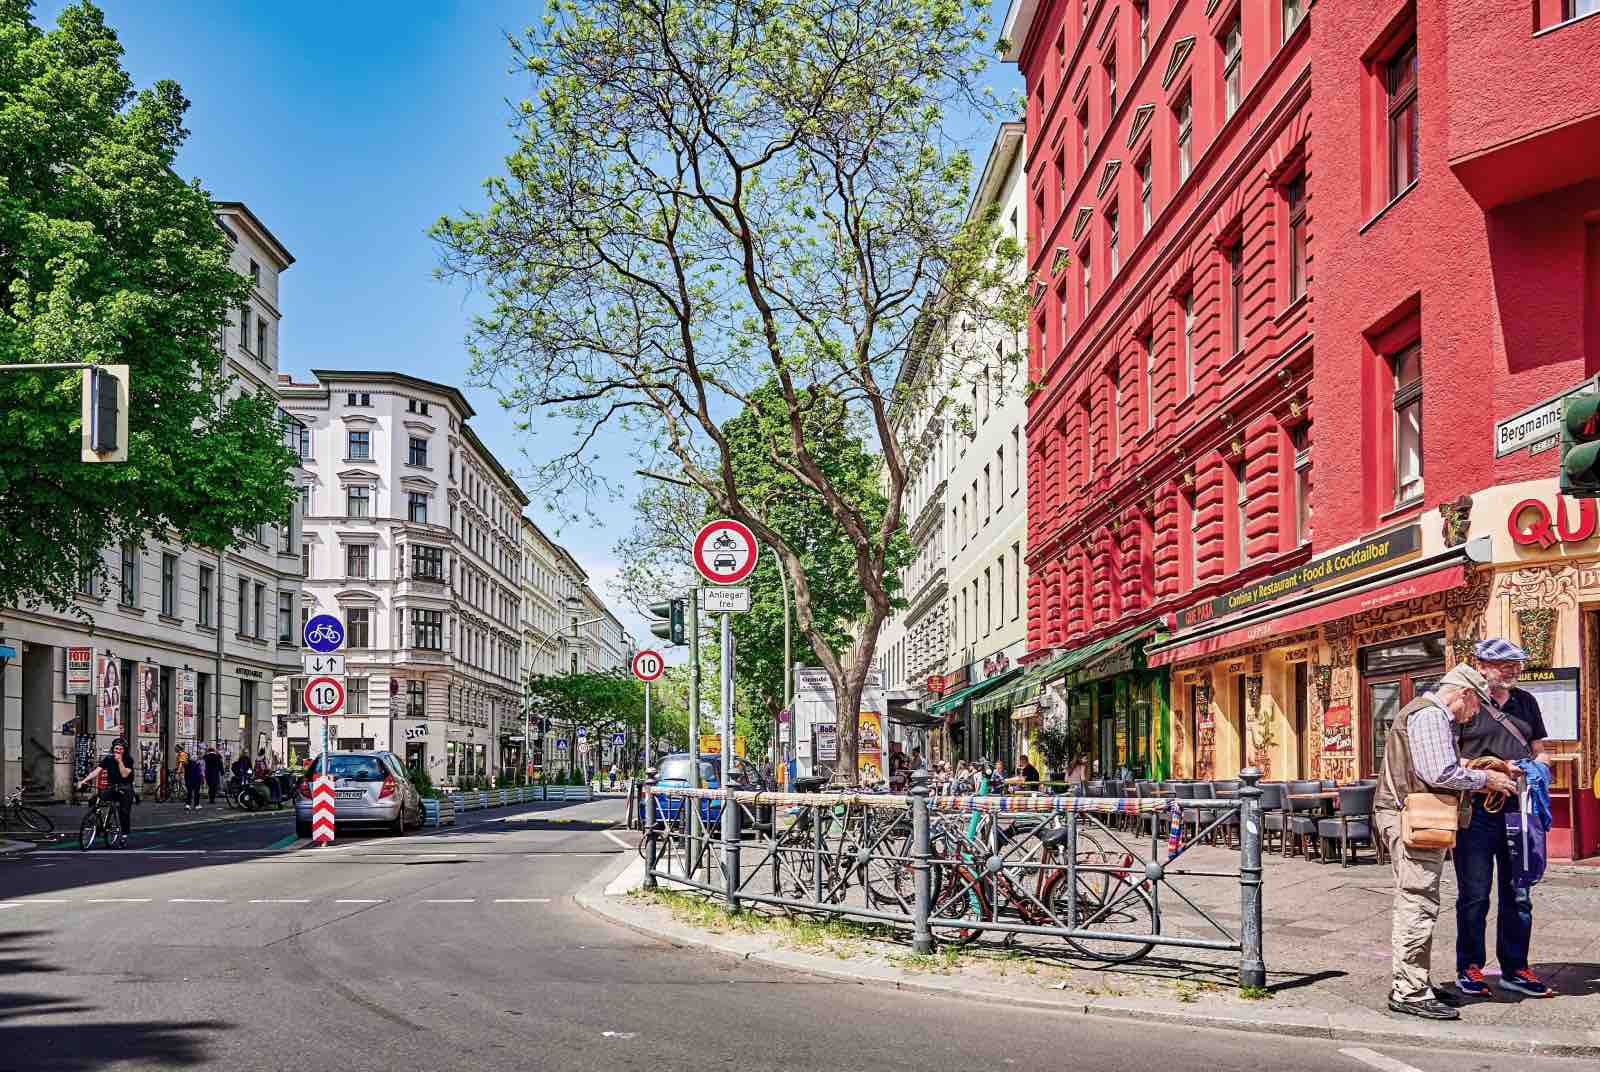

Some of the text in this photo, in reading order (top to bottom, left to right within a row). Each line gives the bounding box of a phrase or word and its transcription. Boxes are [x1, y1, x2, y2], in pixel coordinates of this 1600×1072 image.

[1259, 574, 1297, 597] Restaurant
[1303, 562, 1325, 582] Food
[1326, 559, 1333, 575] &
[1334, 541, 1390, 571] Cocktailbar
[709, 590, 744, 600] Anlieger
[719, 600, 734, 608] frei
[641, 659, 656, 673] 10
[1533, 671, 1555, 681] PASA
[315, 687, 335, 705] 10
